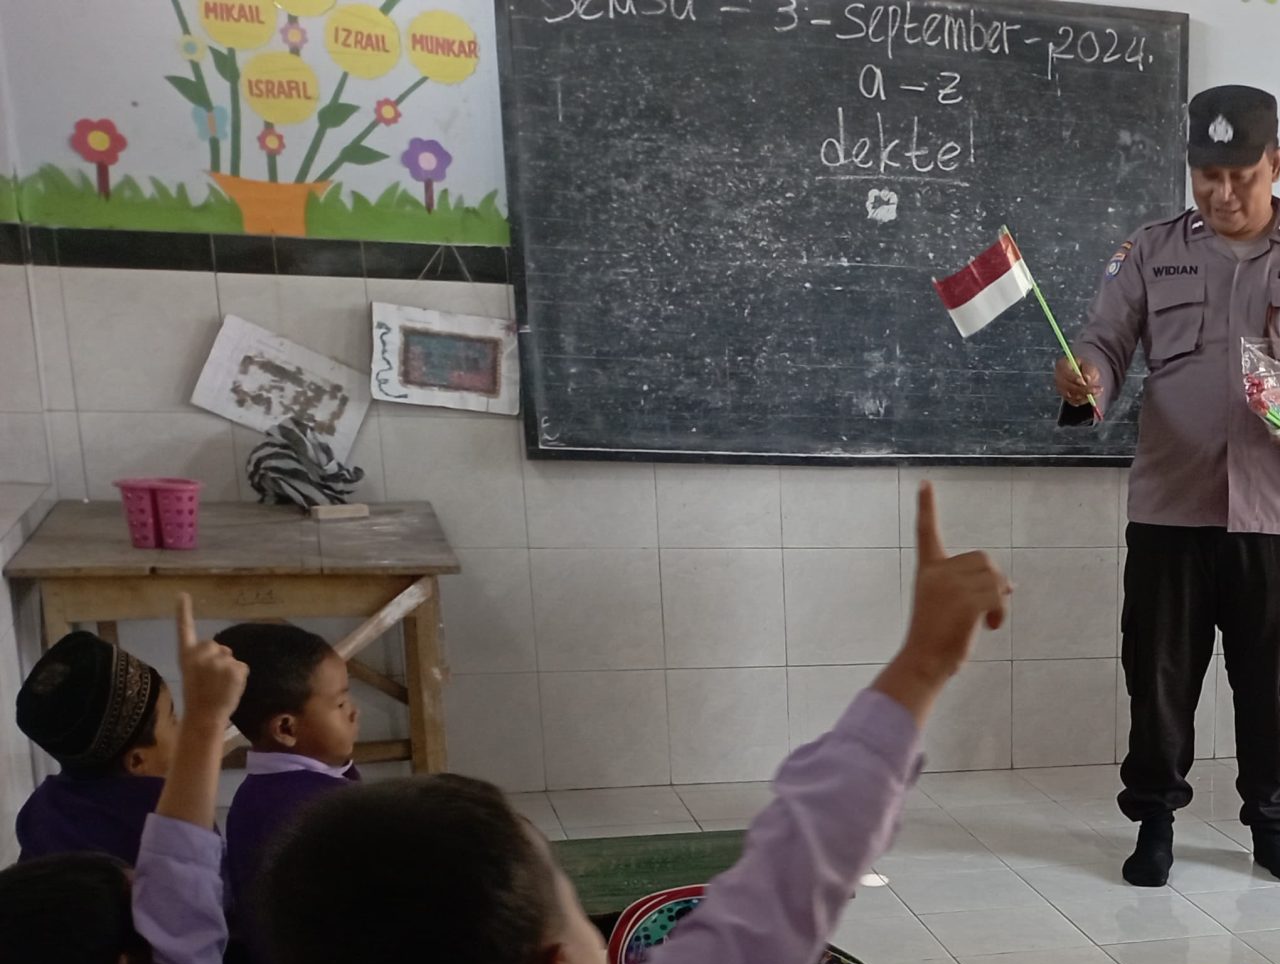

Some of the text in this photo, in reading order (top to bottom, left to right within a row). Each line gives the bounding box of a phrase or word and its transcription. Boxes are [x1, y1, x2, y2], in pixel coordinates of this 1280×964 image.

[204, 1, 265, 24] MIKAIL
[333, 26, 390, 53] IZRAIL
[411, 33, 479, 58] MUNKAR
[1152, 265, 1198, 278] WIDIAN
